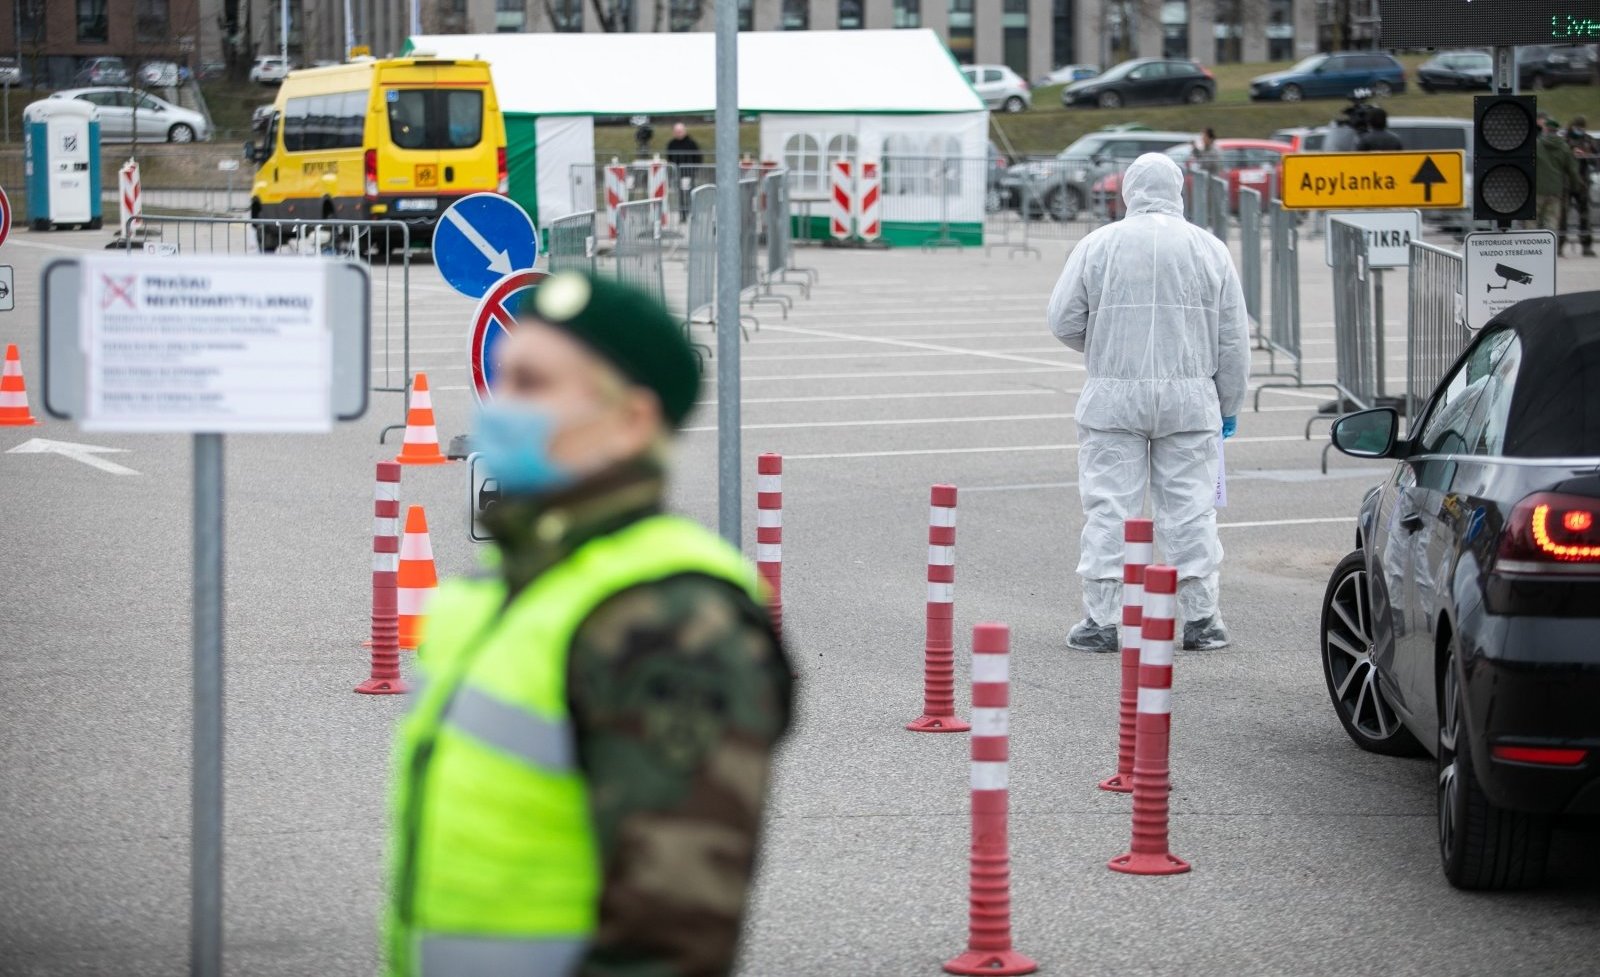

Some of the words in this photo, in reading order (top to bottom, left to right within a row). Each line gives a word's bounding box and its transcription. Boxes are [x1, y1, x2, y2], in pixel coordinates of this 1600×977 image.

[1300, 171, 1396, 195] Apylanka
[1364, 229, 1411, 248] TIKRA
[1515, 238, 1551, 246] VYKDOMAS
